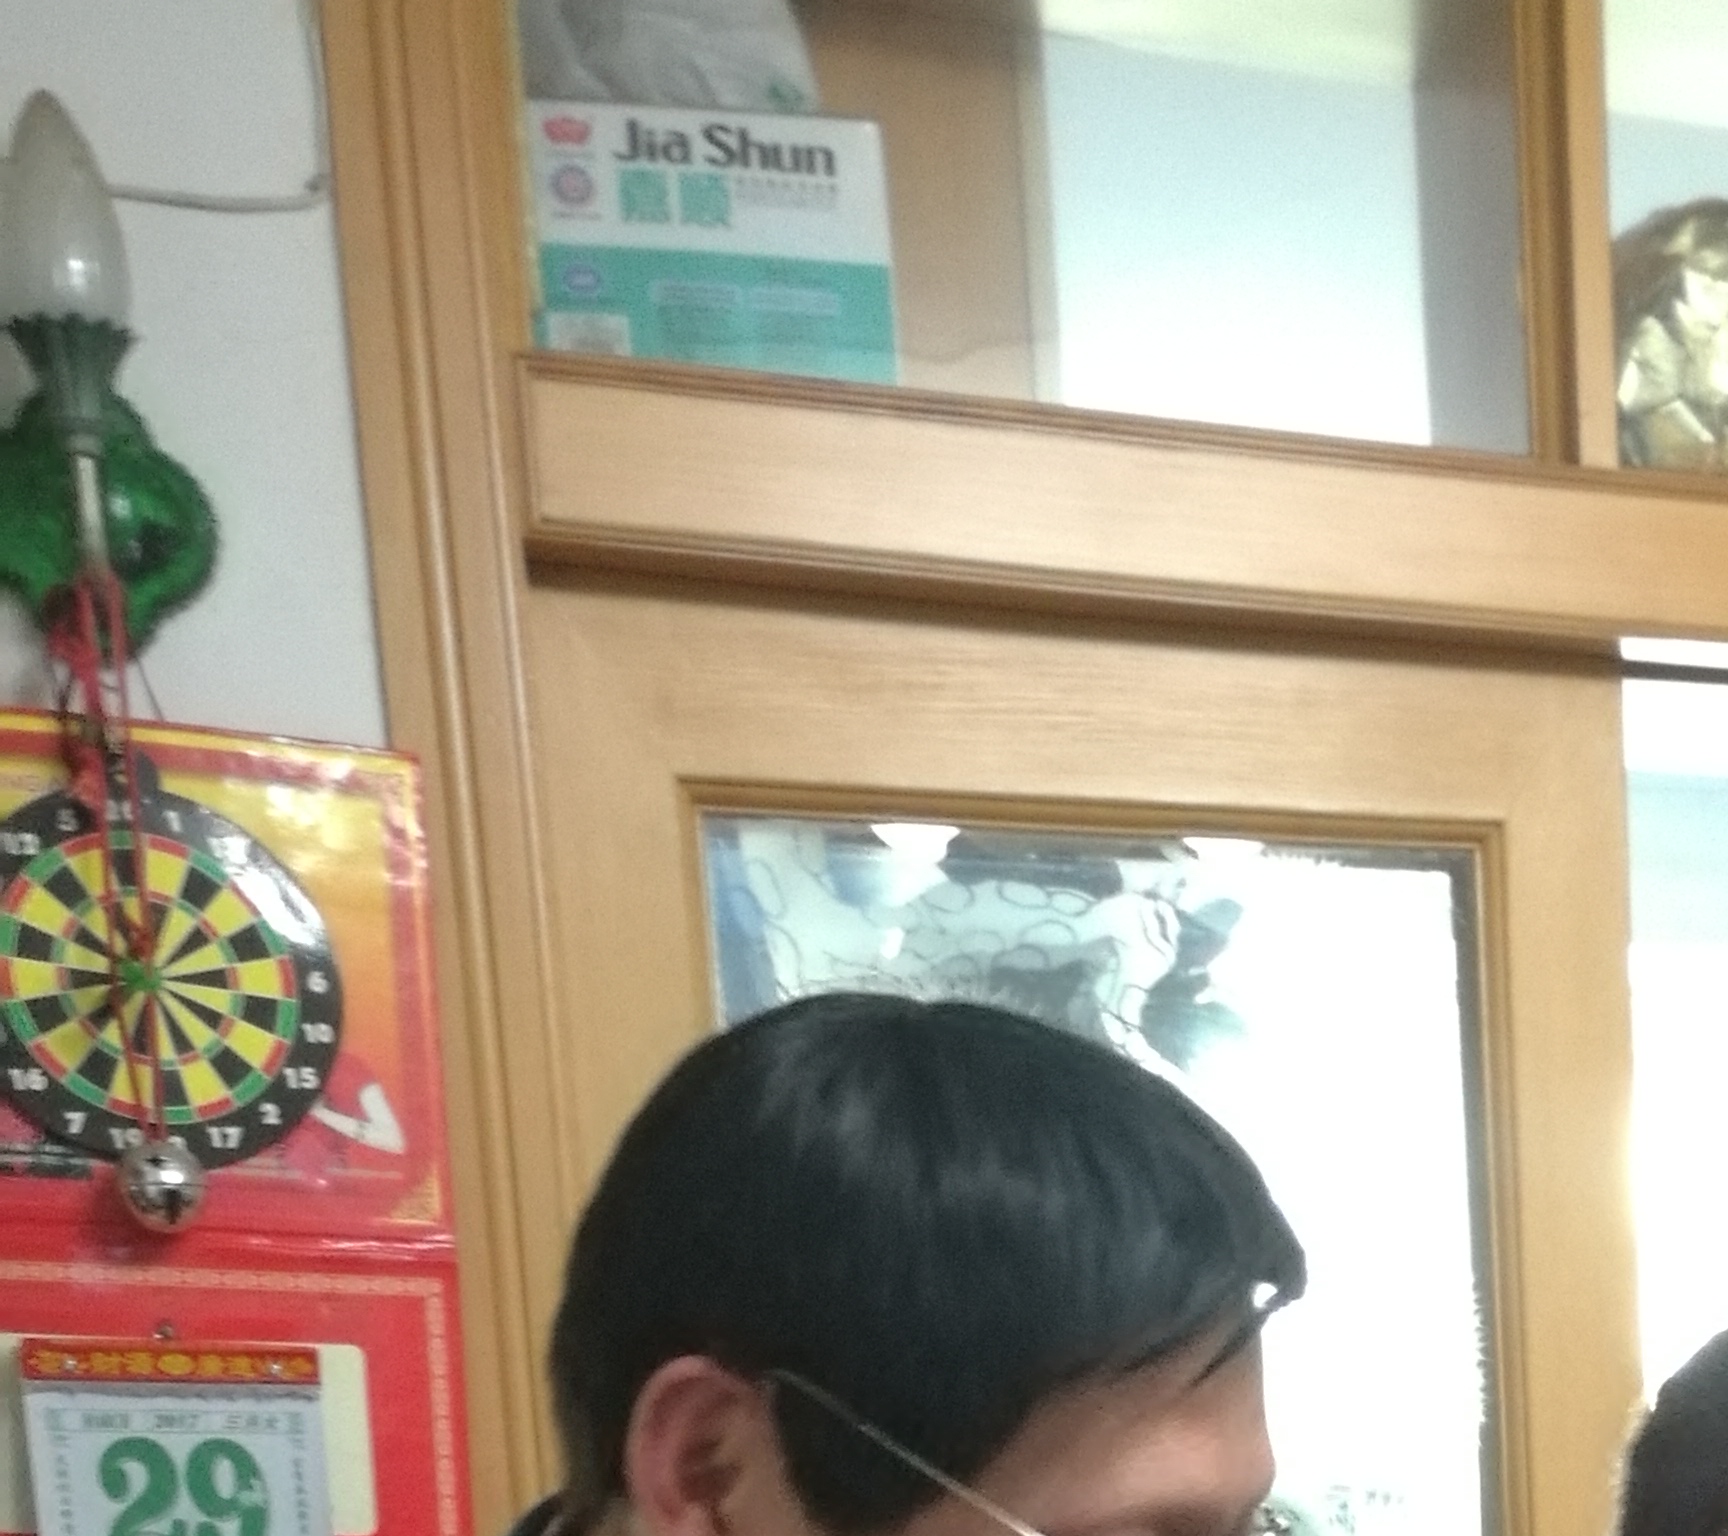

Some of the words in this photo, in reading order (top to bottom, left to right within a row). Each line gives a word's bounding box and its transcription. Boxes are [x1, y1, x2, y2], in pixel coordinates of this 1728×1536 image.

[611, 117, 693, 166] Jia
[701, 121, 838, 177] Shun
[306, 971, 329, 995] 6
[7, 1068, 49, 1091] 16
[283, 1066, 320, 1090] 15
[63, 1111, 87, 1134] 7
[258, 1102, 283, 1126] 2
[206, 1126, 244, 1149] 17
